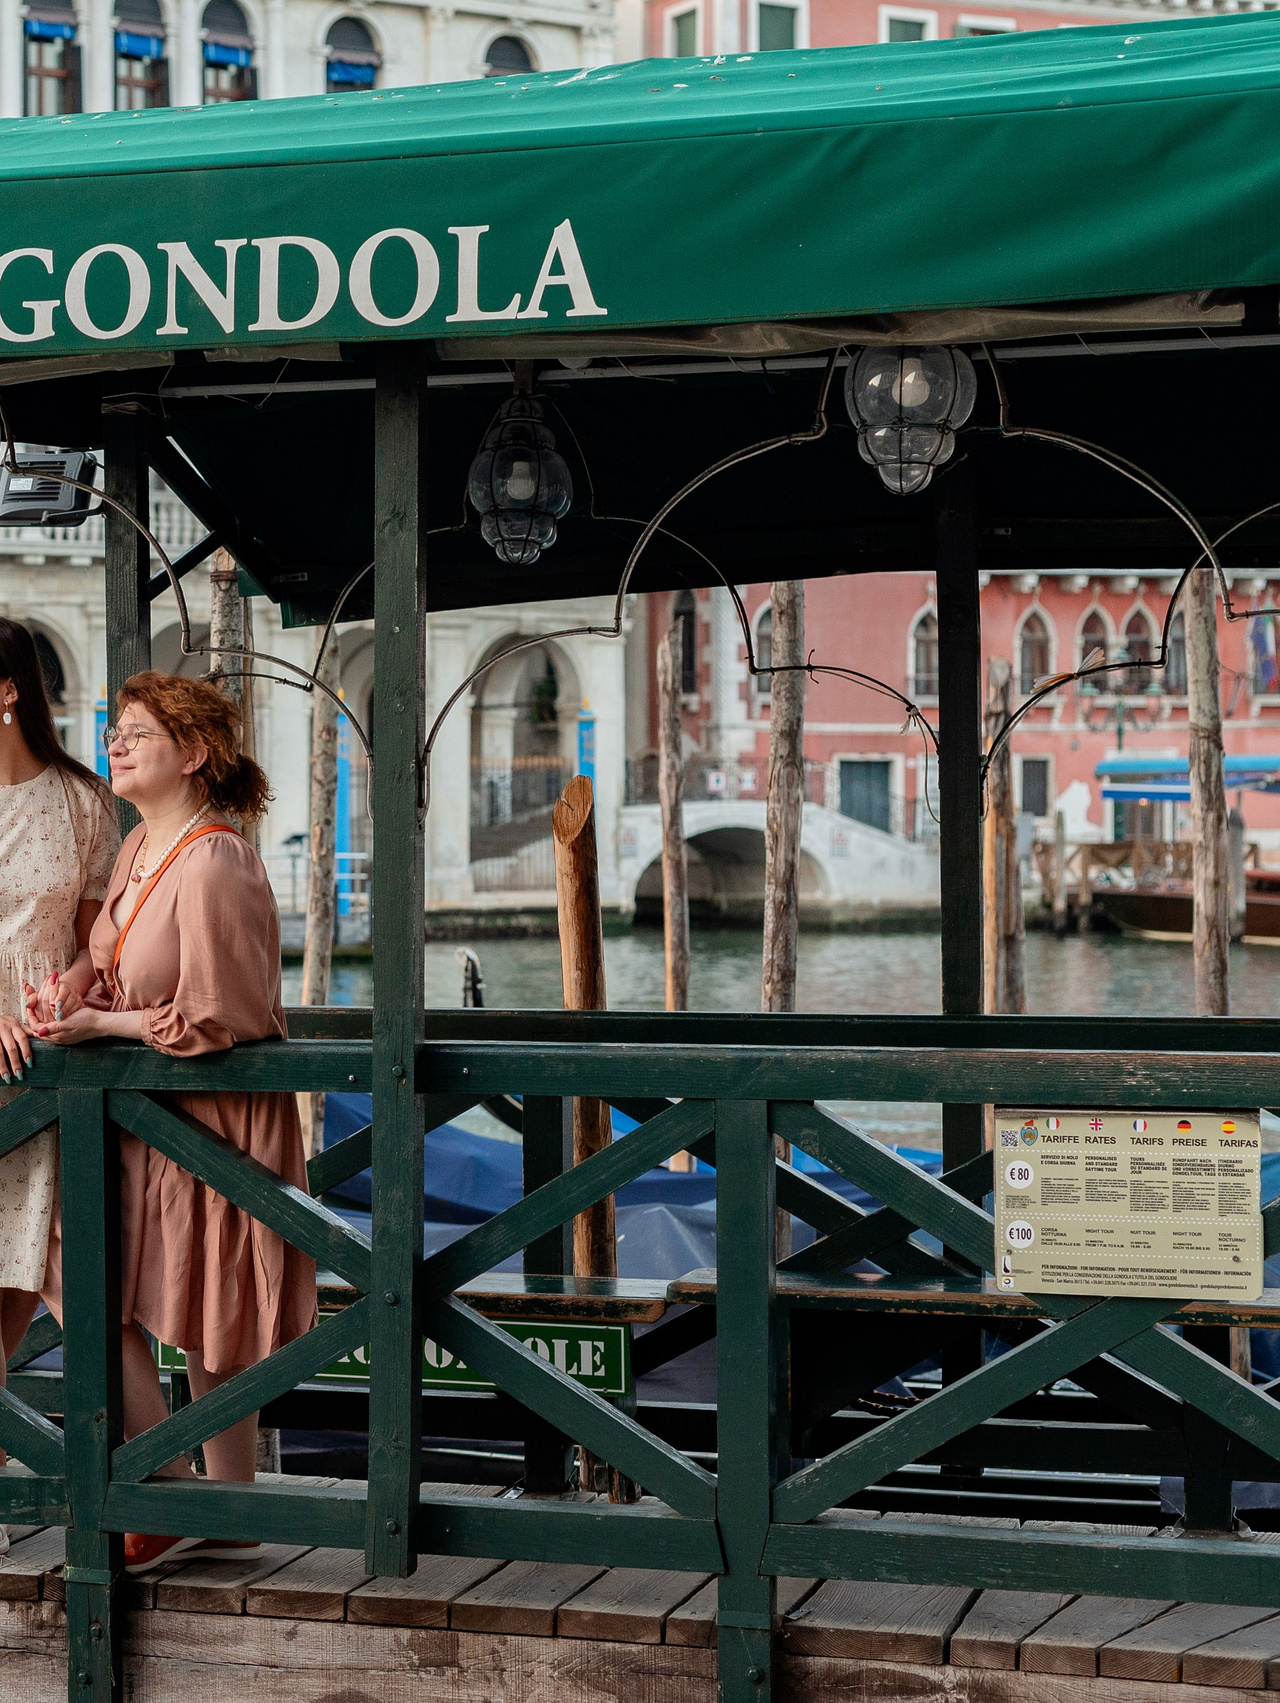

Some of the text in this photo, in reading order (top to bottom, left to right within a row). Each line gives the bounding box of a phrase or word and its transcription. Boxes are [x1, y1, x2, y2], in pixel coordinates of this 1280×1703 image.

[1041, 1135, 1079, 1144] TARIFFE
[1085, 1136, 1116, 1145] RATES
[1130, 1137, 1164, 1146] TARIFS
[1172, 1138, 1207, 1147] PREISE
[1218, 1139, 1258, 1148] TARIFAS
